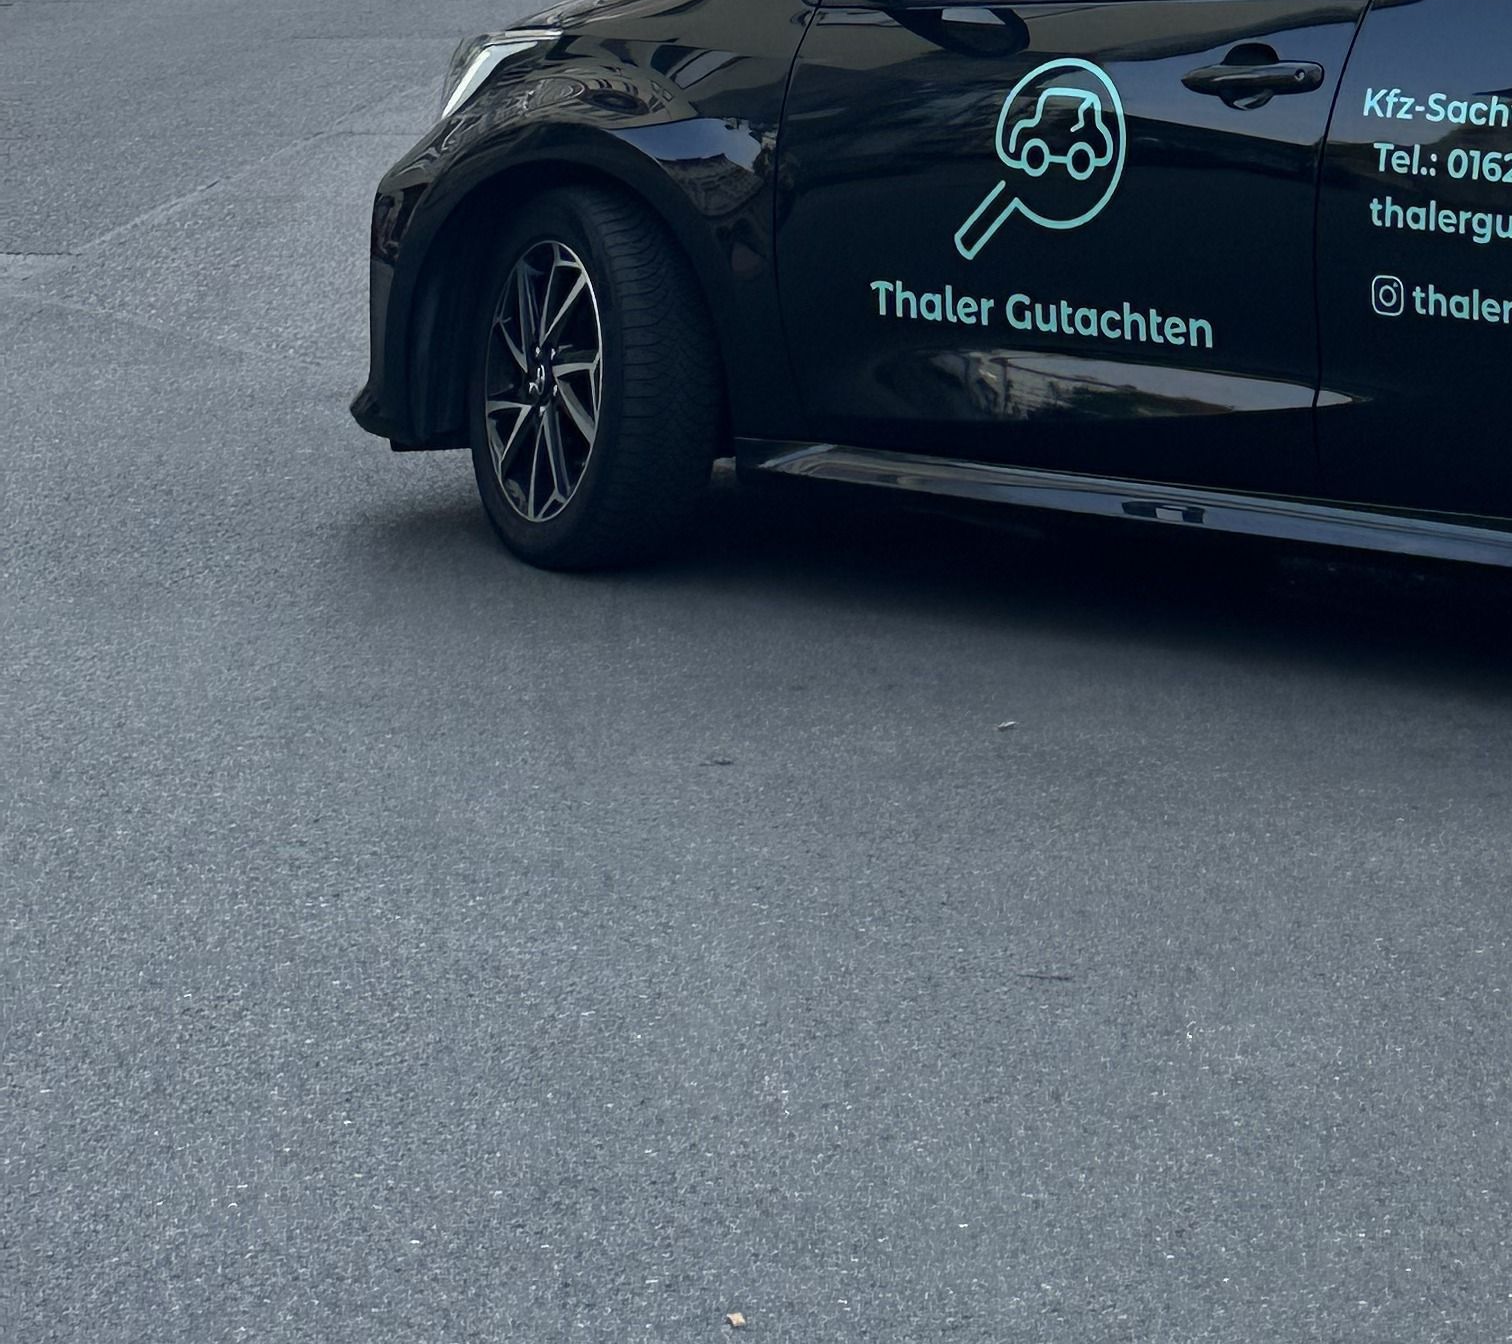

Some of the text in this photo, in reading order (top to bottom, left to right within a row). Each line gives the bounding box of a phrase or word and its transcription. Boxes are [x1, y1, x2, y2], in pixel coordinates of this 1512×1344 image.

[1373, 142, 1438, 177] Tel.:
[869, 279, 1214, 349] Thaler Gutachten
